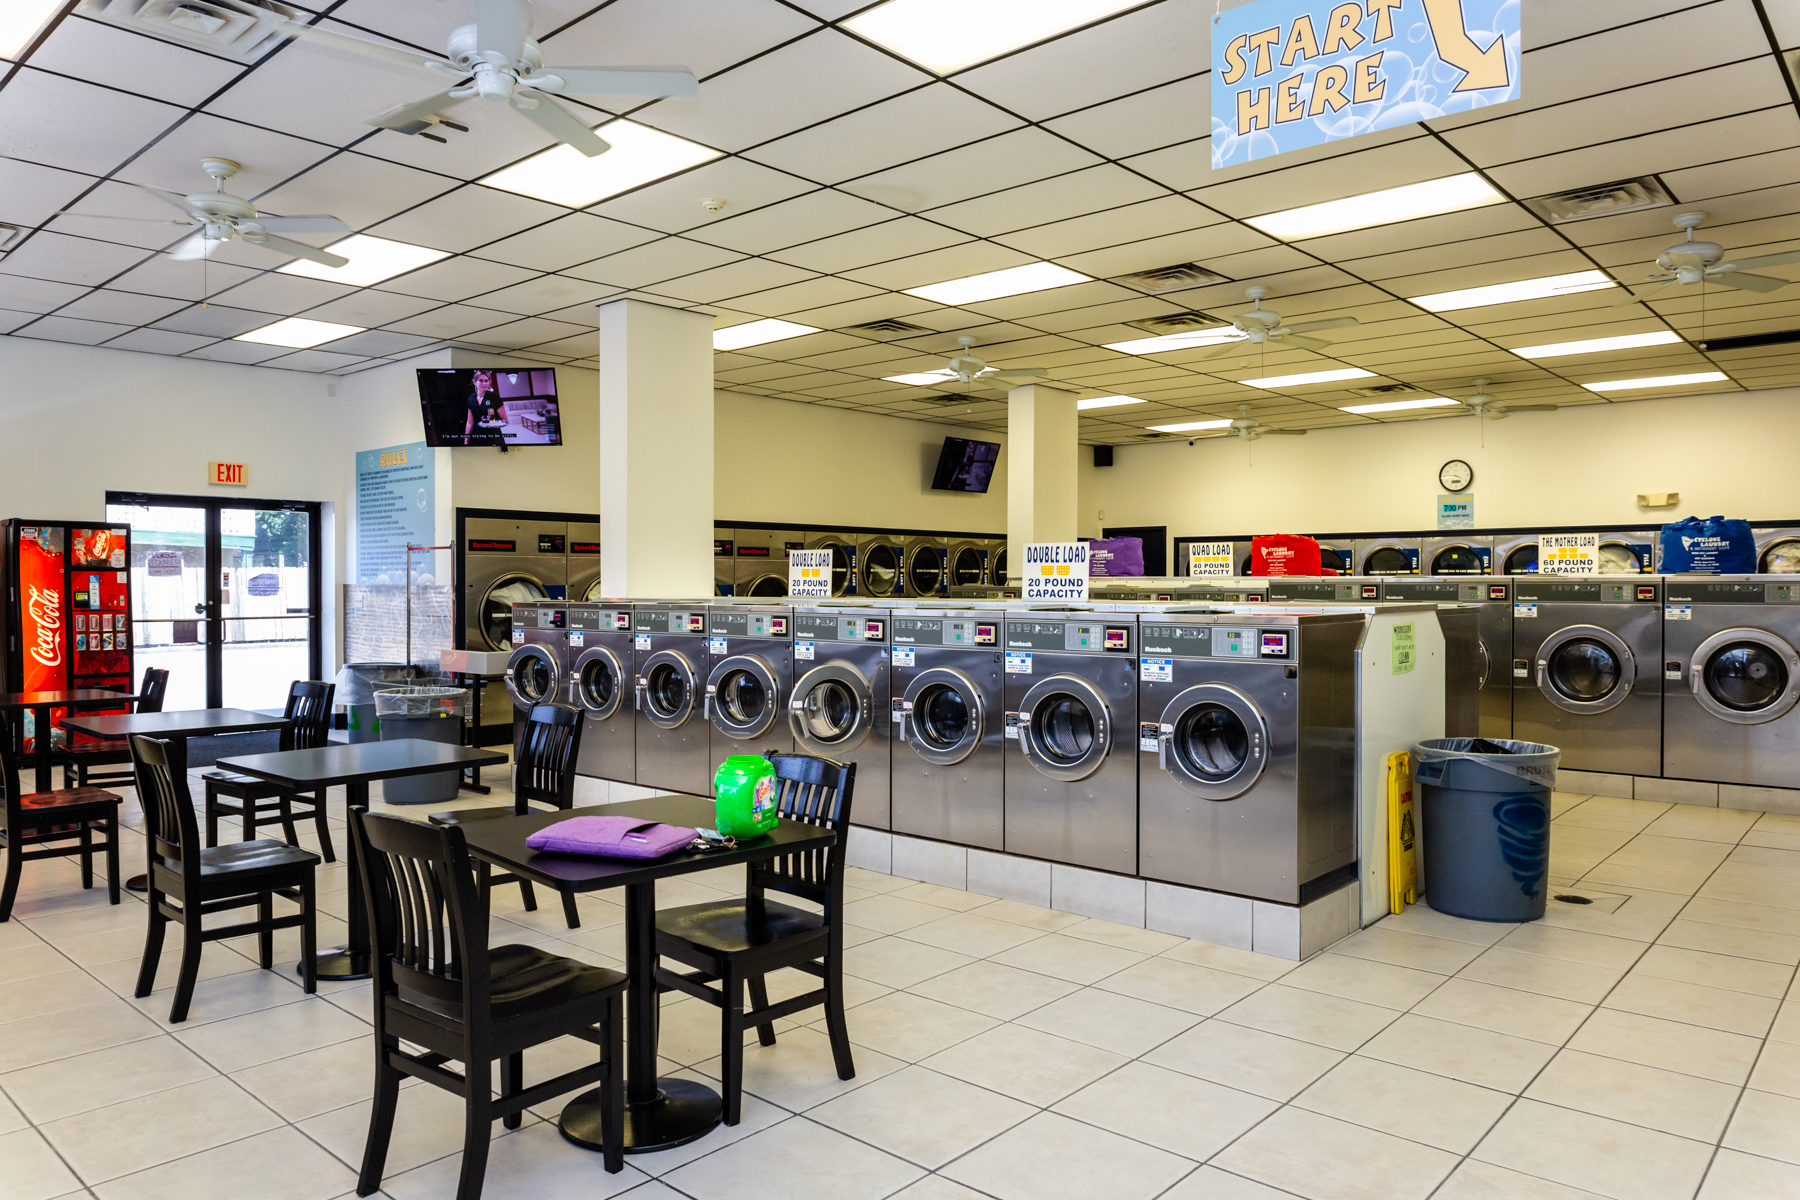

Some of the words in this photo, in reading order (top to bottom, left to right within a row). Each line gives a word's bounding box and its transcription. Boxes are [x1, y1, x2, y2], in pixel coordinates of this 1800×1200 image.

[1219, 0, 1403, 86] START
[1236, 49, 1387, 137] HERE
[380, 448, 408, 468] RULES
[217, 463, 243, 484] EXIT
[1542, 537, 1553, 547] THE
[1555, 537, 1578, 547] MOTHER
[1580, 536, 1595, 546] LOAD
[1028, 546, 1060, 563] DOUBLE
[1063, 546, 1086, 563] LOAD
[1192, 544, 1210, 556] QUAD
[1213, 544, 1230, 555] LOAD
[792, 552, 813, 567] DOUBLE
[815, 552, 830, 567] LOAD
[1028, 579, 1040, 587] 20
[1045, 578, 1083, 587] POUND
[1028, 589, 1083, 597] CAPACITY
